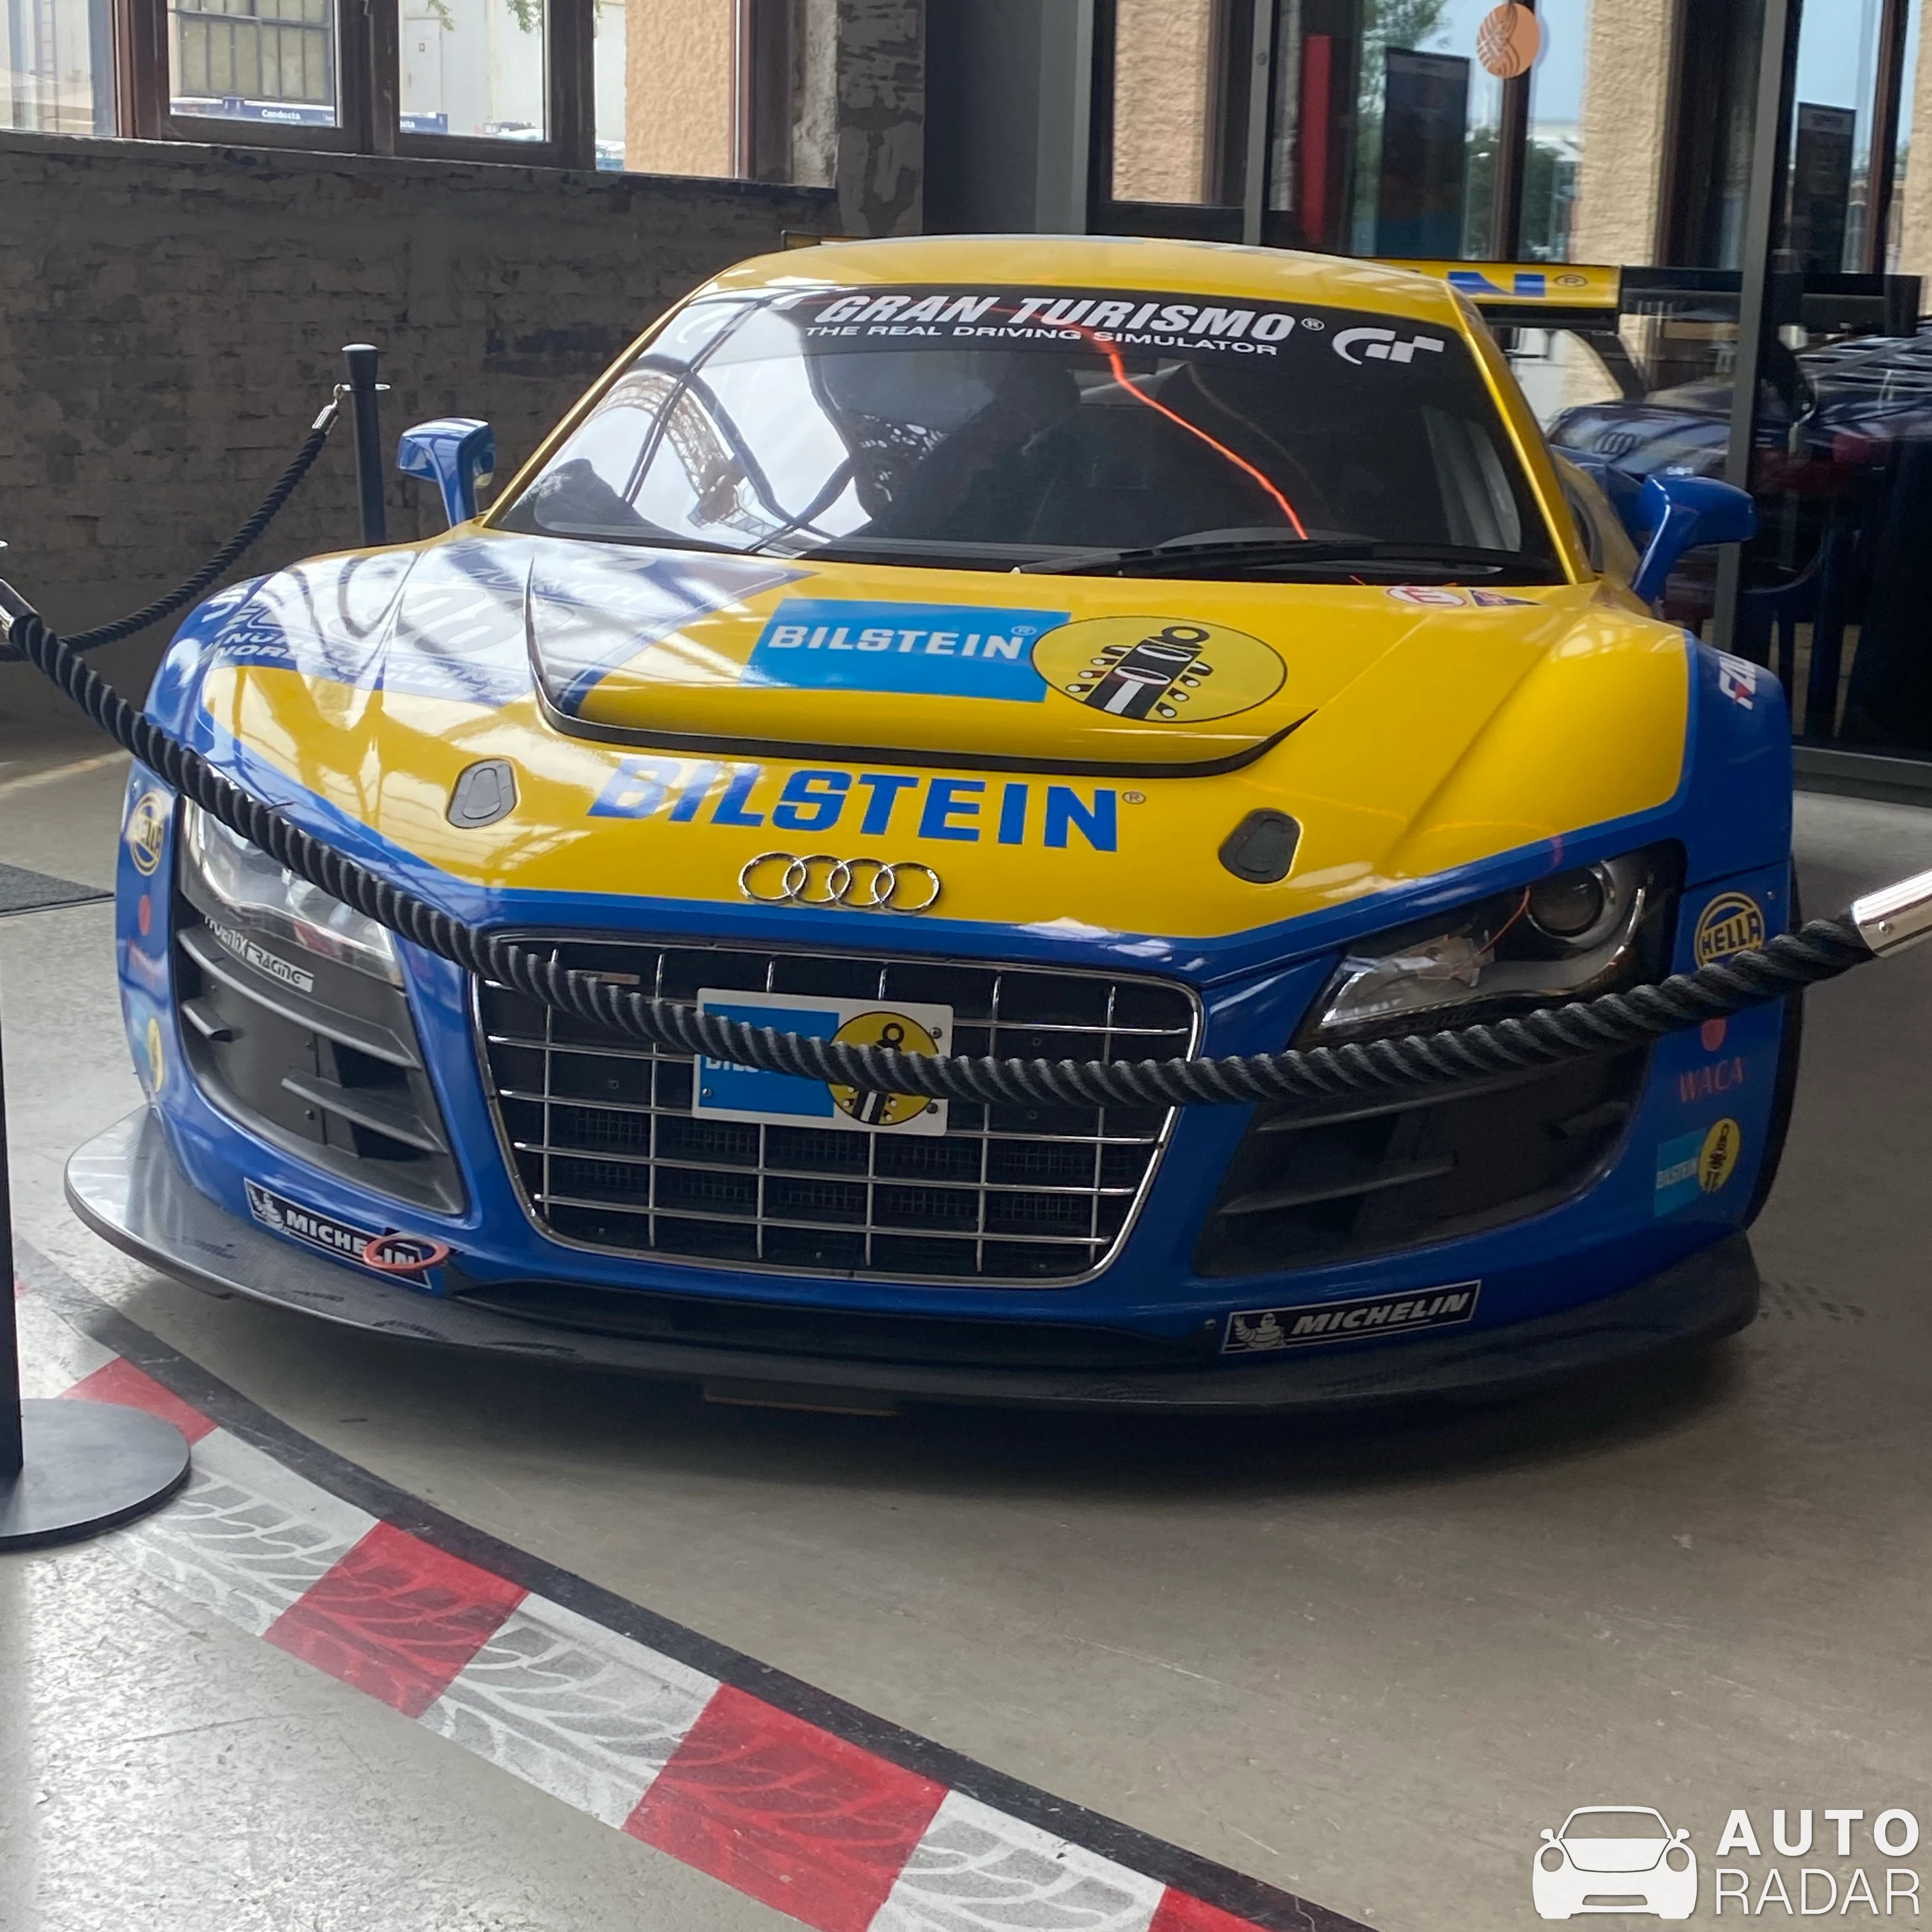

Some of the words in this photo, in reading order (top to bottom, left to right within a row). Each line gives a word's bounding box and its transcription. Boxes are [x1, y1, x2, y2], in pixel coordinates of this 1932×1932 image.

[815, 295, 1001, 324] GRAN
[804, 326, 859, 338] THE
[867, 325, 942, 337] REAL
[953, 326, 1082, 341] DRIVING
[1093, 331, 1278, 356] SIMULATOR
[1701, 910, 1761, 956] HELLA
[286, 1209, 416, 1265] MICHEIN
[1291, 1292, 1471, 1335] MICHELIN
